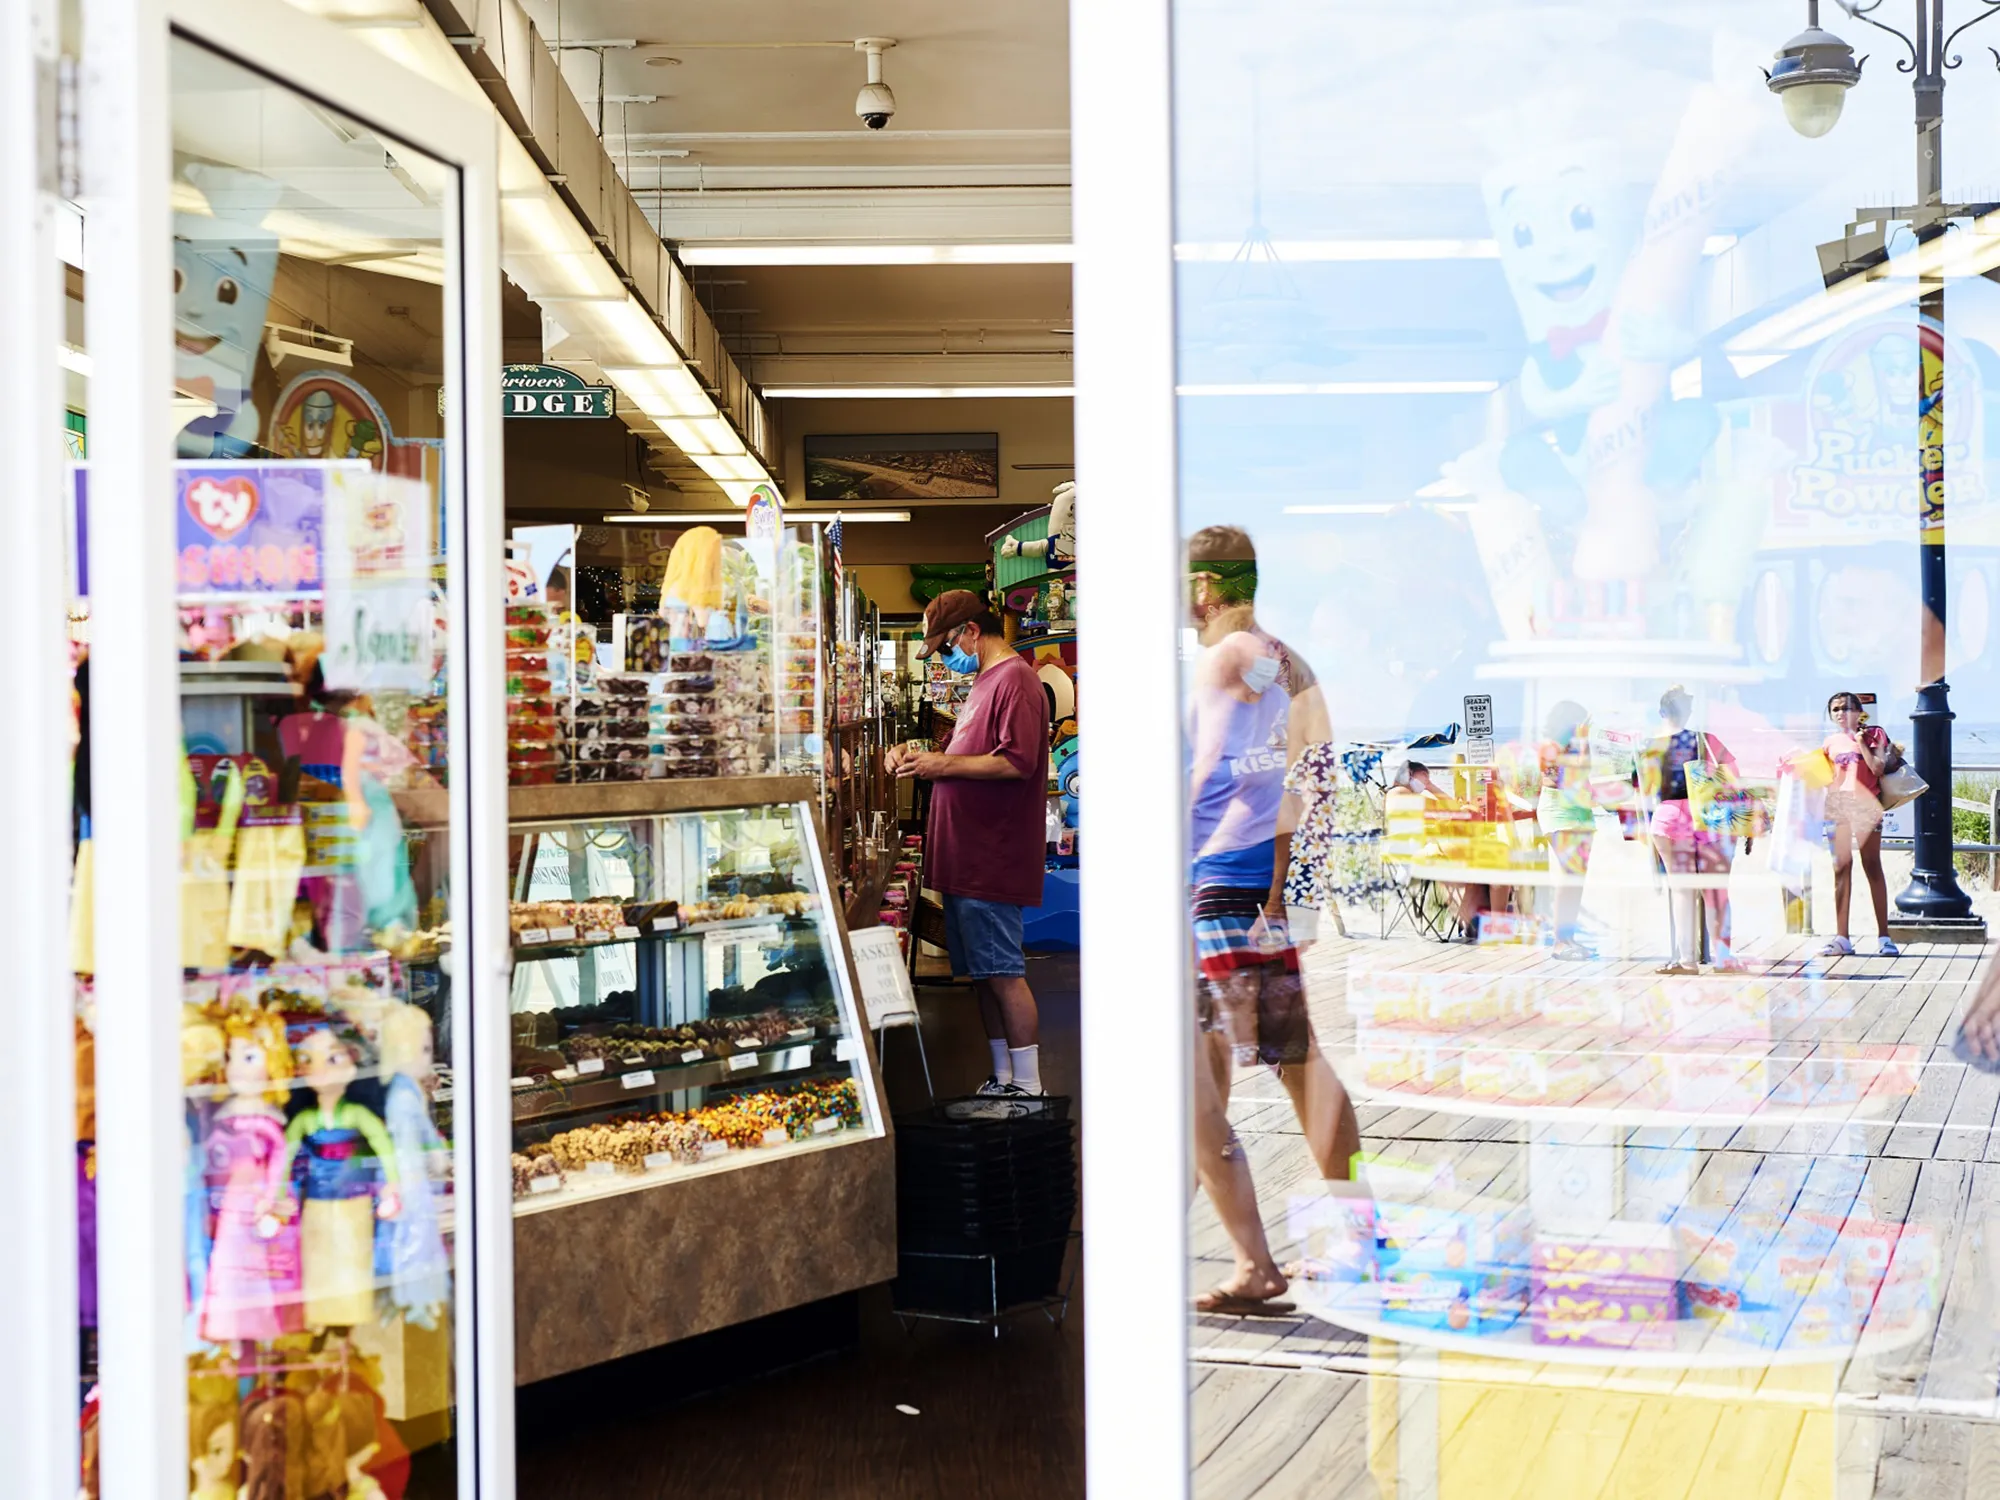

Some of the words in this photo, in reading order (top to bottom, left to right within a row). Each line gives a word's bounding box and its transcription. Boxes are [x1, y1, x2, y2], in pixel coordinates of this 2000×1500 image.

[501, 372, 567, 388] hriver's
[504, 393, 594, 414] DGE
[191, 481, 252, 530] ty
[1230, 751, 1288, 776] KISS
